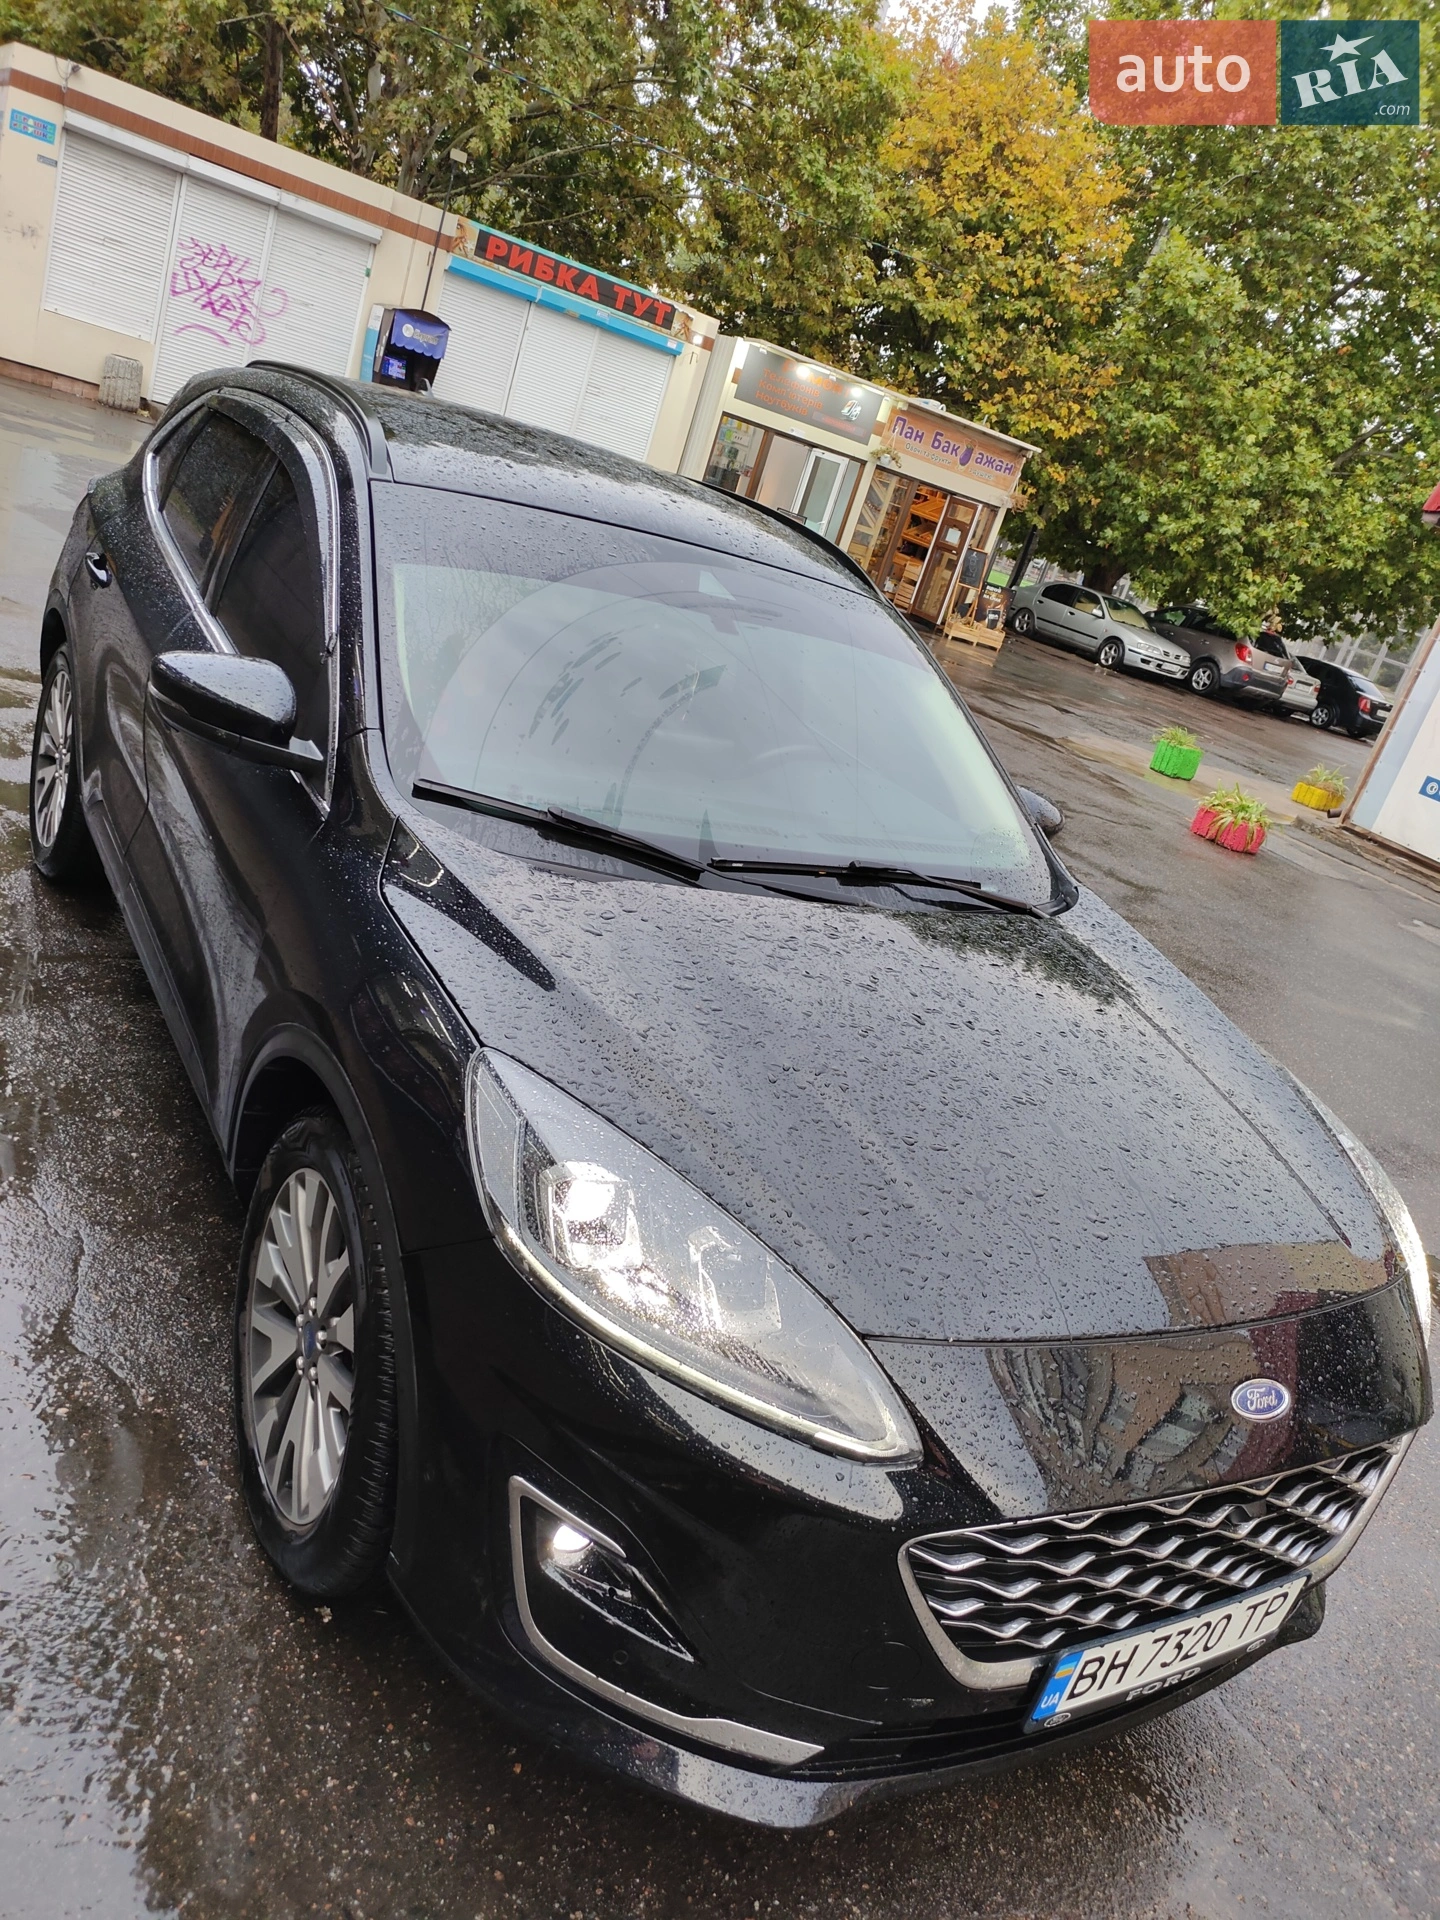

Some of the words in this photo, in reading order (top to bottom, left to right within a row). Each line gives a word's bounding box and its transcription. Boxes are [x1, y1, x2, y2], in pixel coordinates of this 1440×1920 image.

[485, 235, 600, 301] РИБКА
[613, 284, 672, 325] ТУТ
[763, 367, 820, 397] Телефонів
[782, 358, 853, 398] Рмонт
[755, 391, 808, 416] Ноутбуків
[892, 416, 925, 443] Пан
[1246, 1387, 1278, 1411] Ford
[1136, 1613, 1233, 1678] 7320
[1125, 1667, 1201, 1701] FORD
[1041, 1691, 1060, 1709] UA
